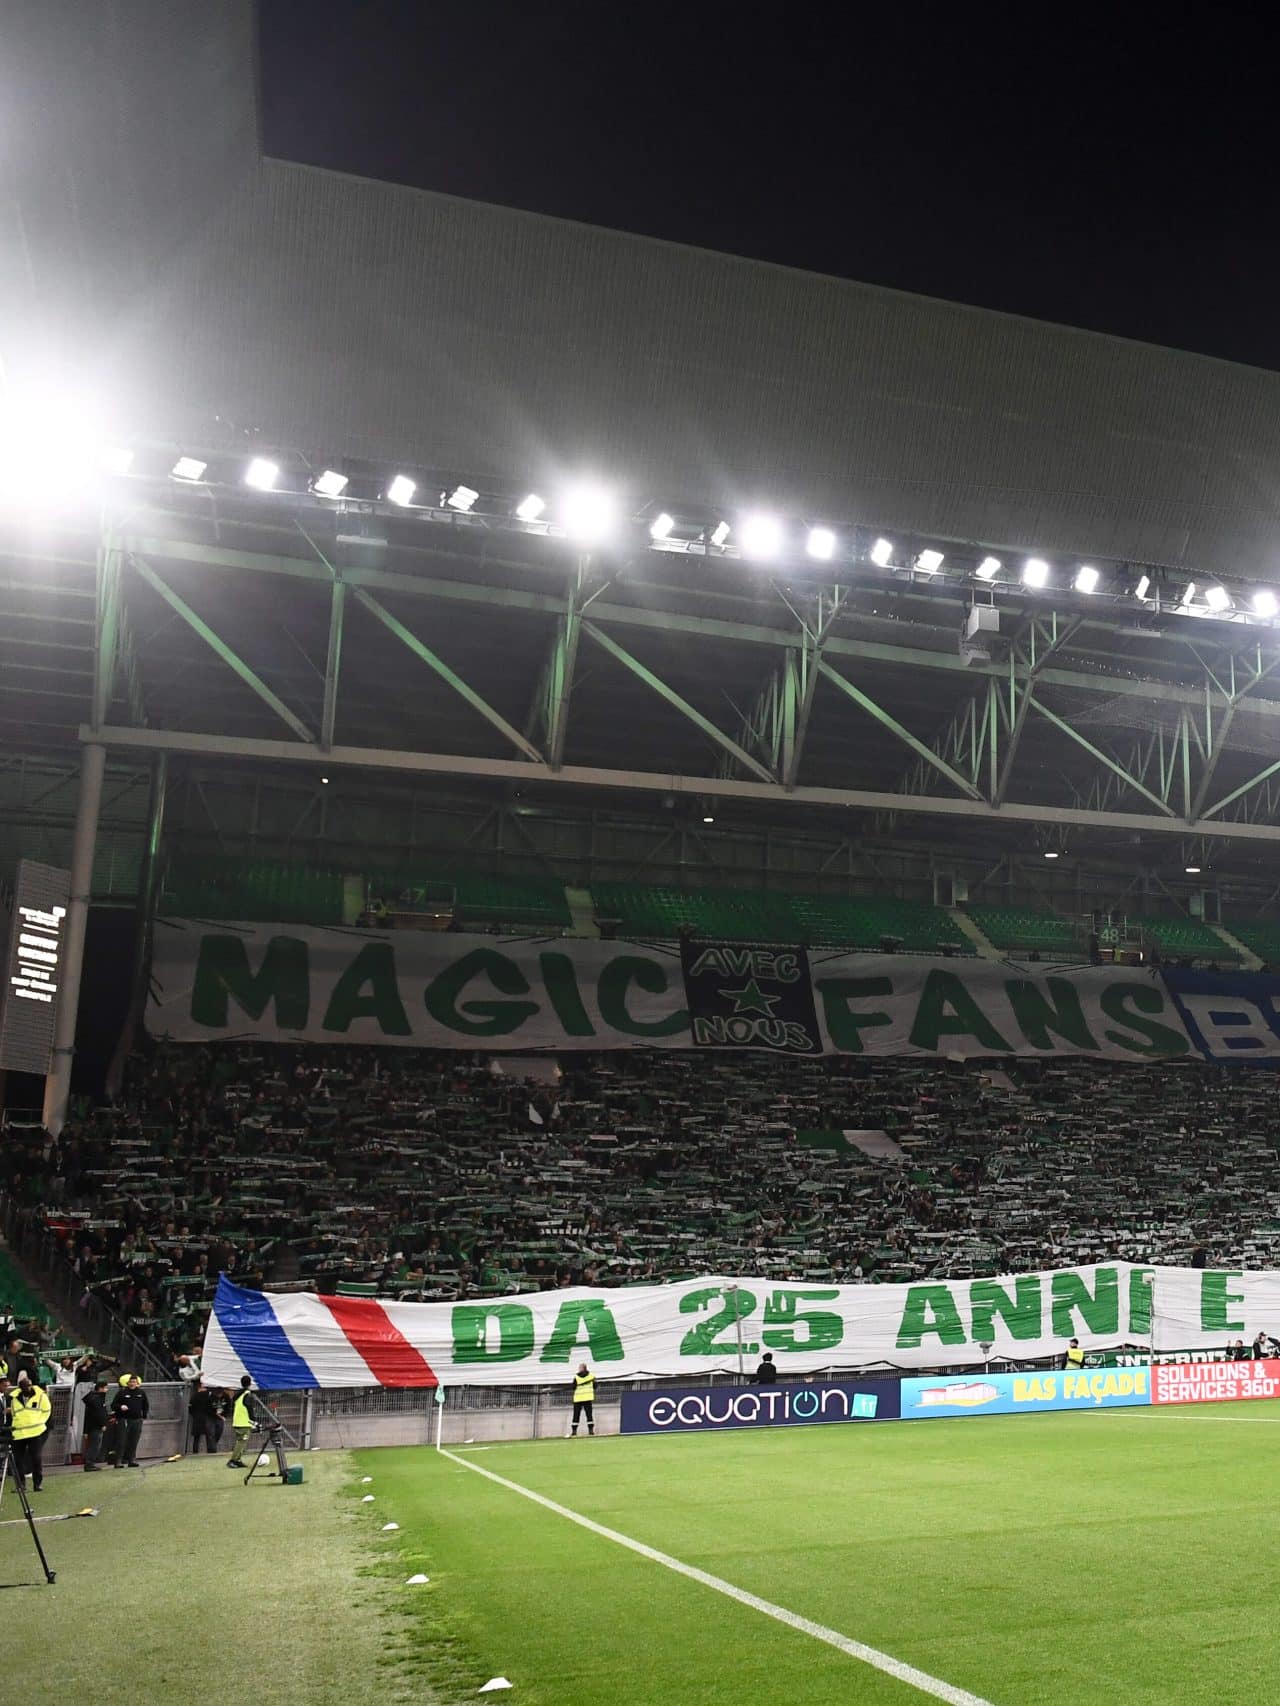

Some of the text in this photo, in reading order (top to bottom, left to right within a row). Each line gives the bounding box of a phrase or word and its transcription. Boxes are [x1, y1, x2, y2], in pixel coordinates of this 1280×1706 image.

[1100, 928, 1119, 943] 48
[689, 948, 801, 983] AVEC
[191, 935, 1191, 1056] MAGIC FANS
[693, 1016, 814, 1050] NOUS
[451, 1299, 625, 1364] DA
[679, 1286, 844, 1355] 25
[896, 1267, 1156, 1349] ANNI
[1200, 1271, 1245, 1331] E
[1013, 1373, 1147, 1403] BAS FAÇADE
[1157, 1361, 1267, 1383] SOLUTIONS &
[1157, 1380, 1237, 1401] SERVICES
